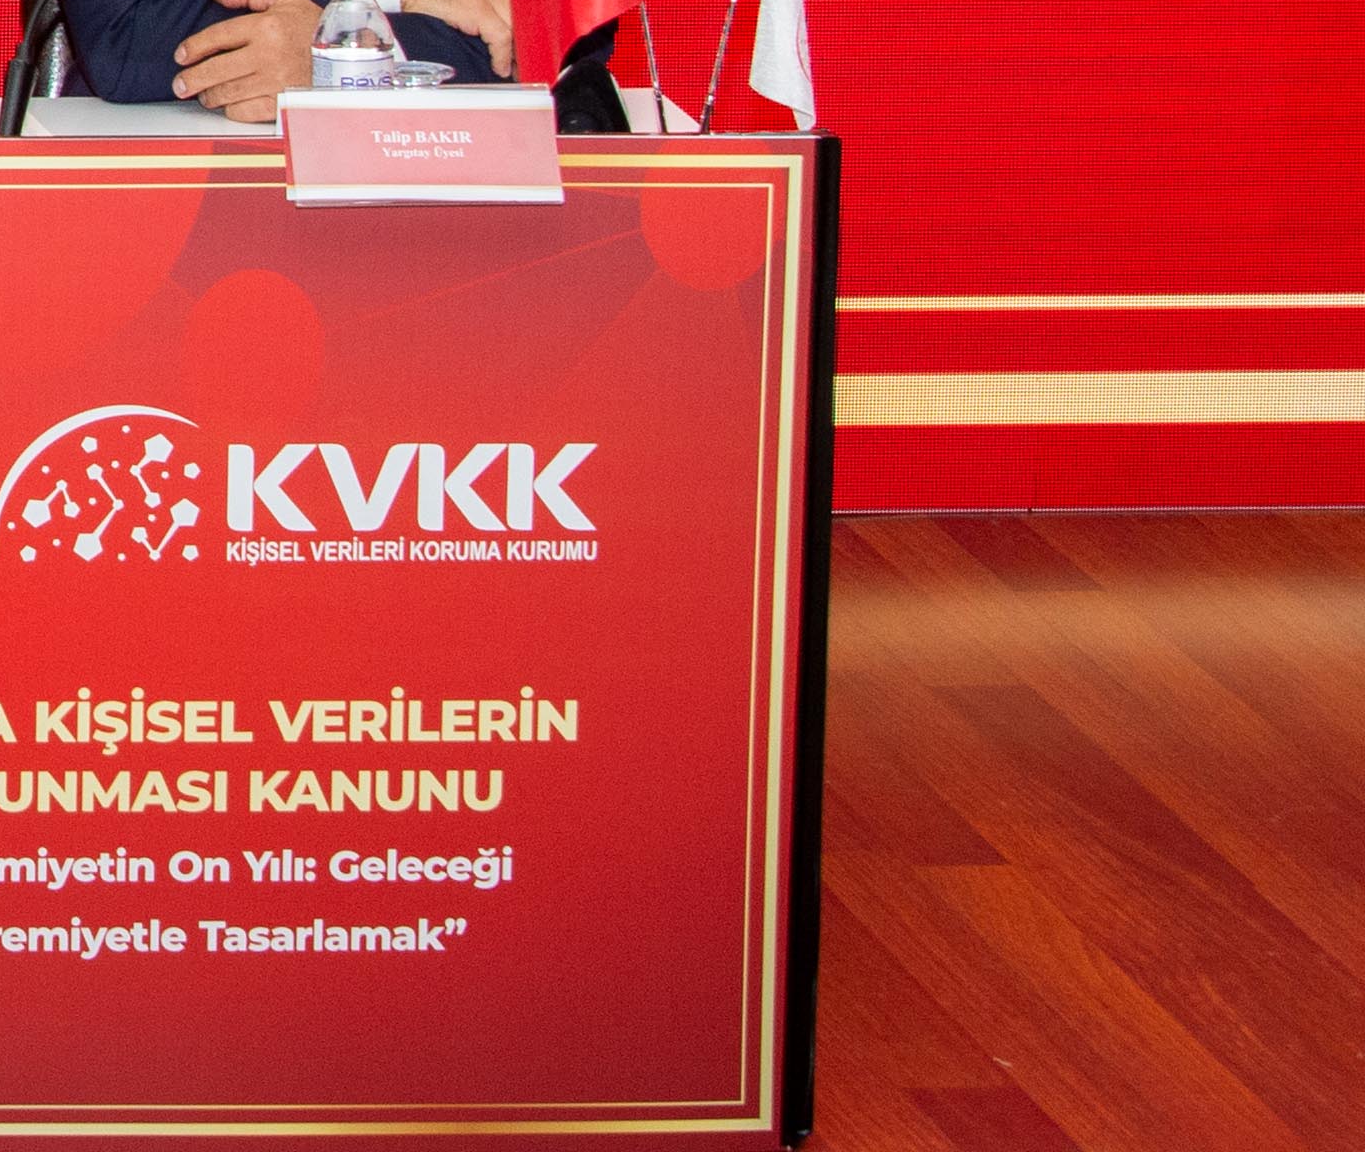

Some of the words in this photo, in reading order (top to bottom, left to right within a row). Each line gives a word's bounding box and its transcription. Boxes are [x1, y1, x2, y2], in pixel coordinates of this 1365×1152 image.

[371, 130, 411, 146] Talip
[415, 131, 472, 143] BAKIR
[227, 443, 597, 532] KVKK
[227, 537, 305, 566] KİŞİSEL
[310, 536, 404, 561] VERİLERİ
[410, 541, 501, 561] KORUMA
[507, 541, 597, 560] KURUMU
[36, 687, 253, 755] KİŞİSEL
[269, 686, 578, 742] VERİLERİN
[250, 770, 503, 812] KANUNU
[169, 851, 230, 882] On
[243, 849, 316, 881] Yılı:
[329, 846, 512, 889] Geleceği
[198, 918, 466, 952] Tasarlamak”
